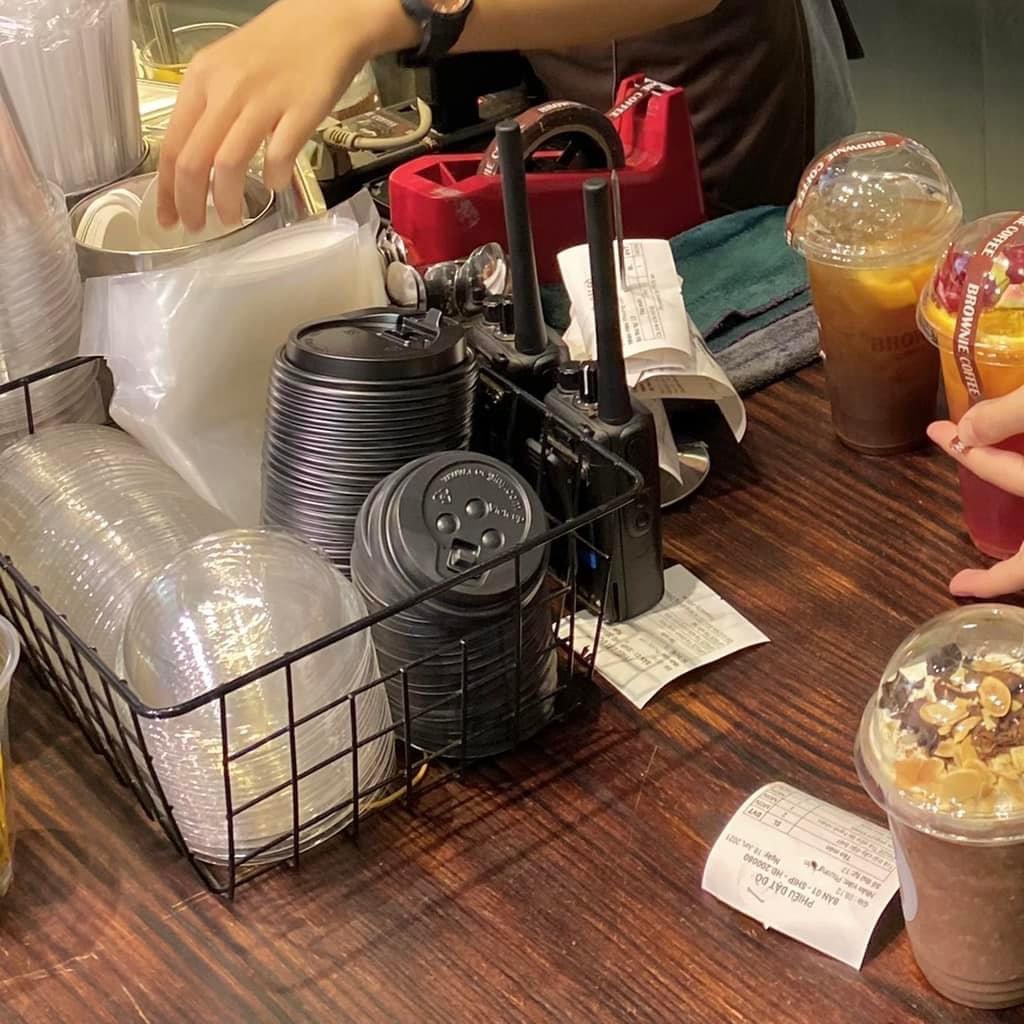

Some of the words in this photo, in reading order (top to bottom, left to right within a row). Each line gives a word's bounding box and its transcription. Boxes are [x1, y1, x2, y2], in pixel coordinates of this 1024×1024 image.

[827, 138, 886, 162] BROWNIE
[981, 224, 1019, 259] COFFEE
[956, 282, 980, 355] BROWNIE
[960, 357, 981, 397] COFFEE
